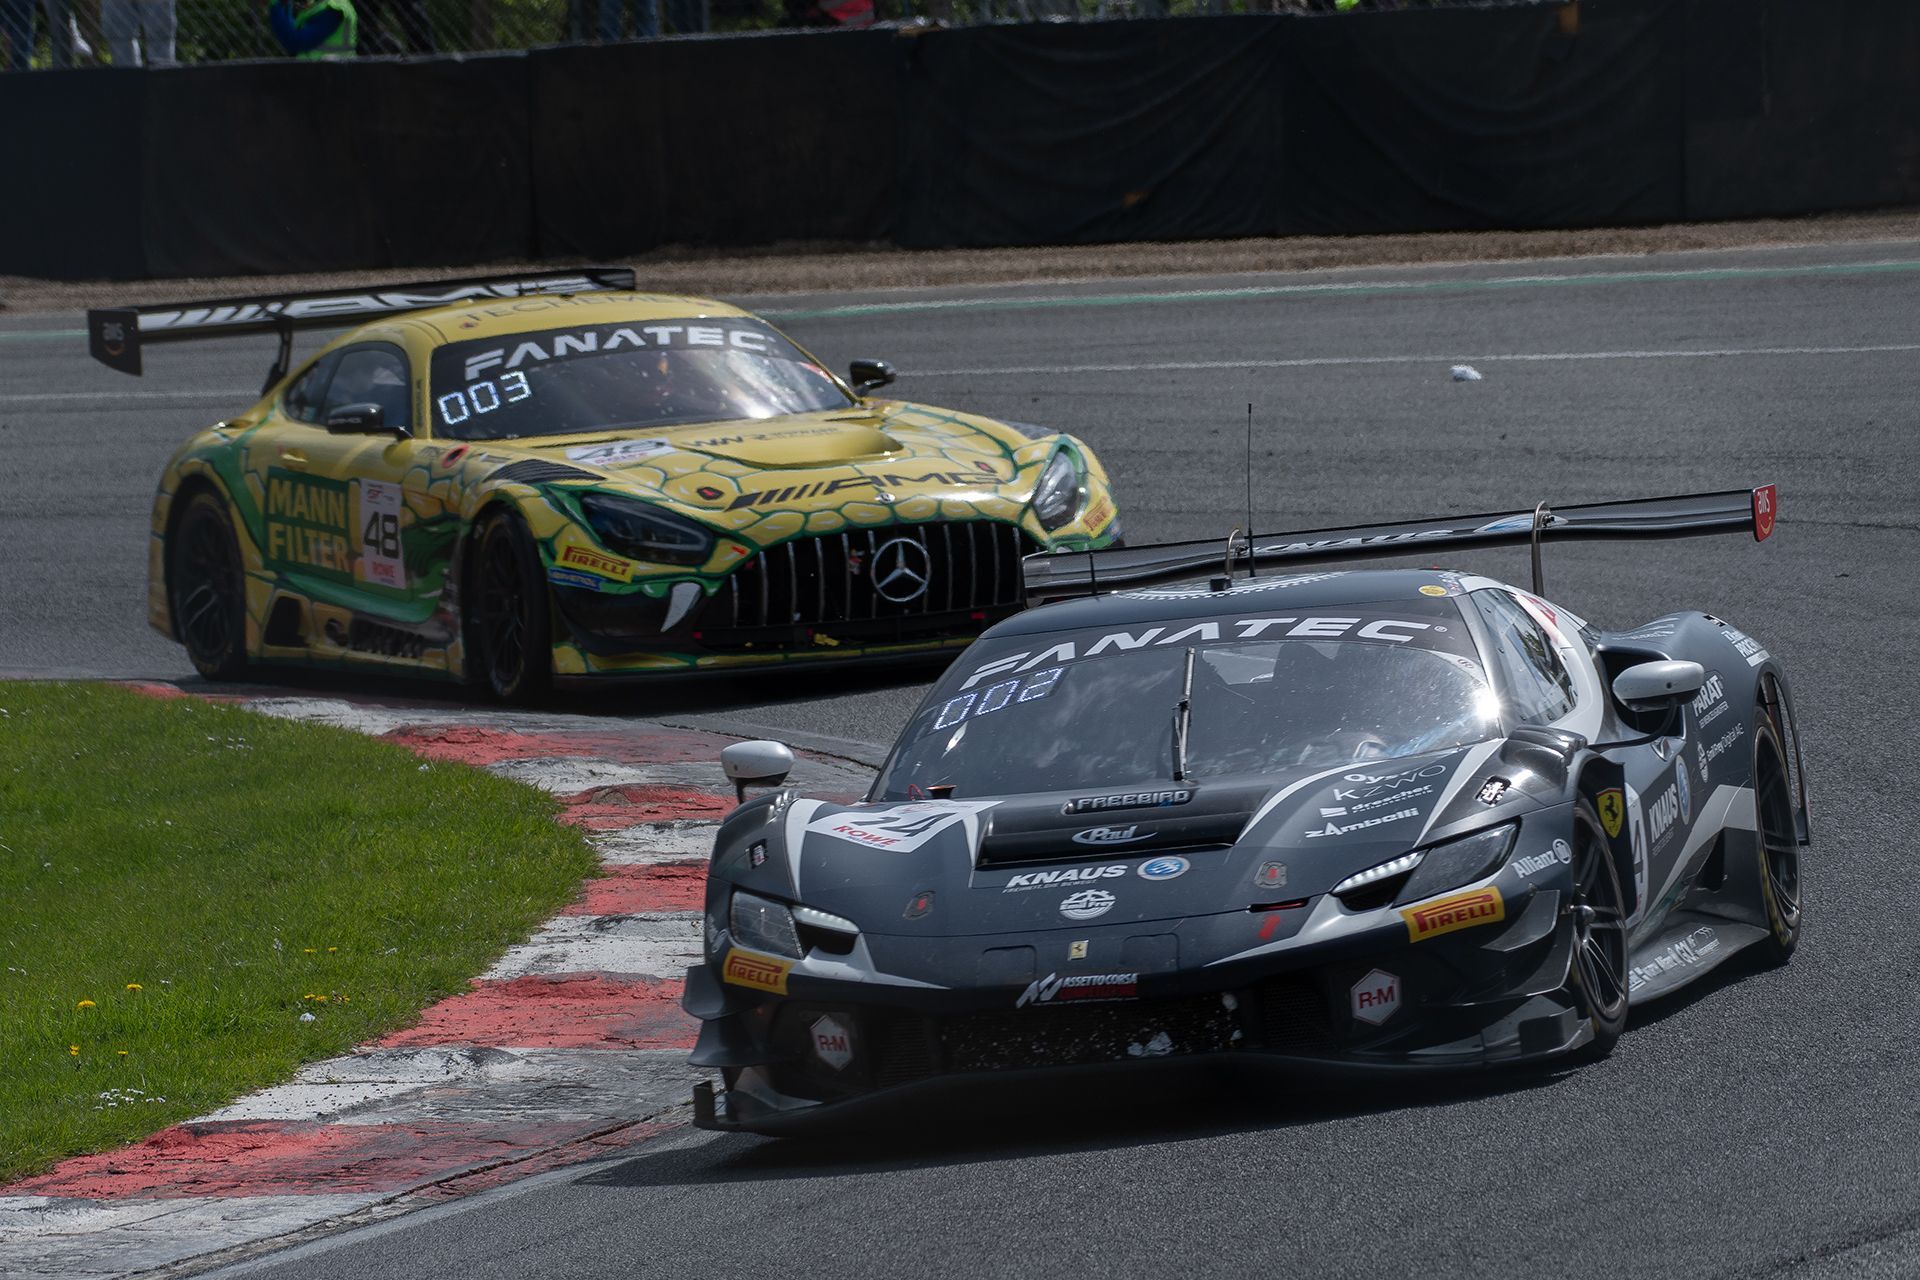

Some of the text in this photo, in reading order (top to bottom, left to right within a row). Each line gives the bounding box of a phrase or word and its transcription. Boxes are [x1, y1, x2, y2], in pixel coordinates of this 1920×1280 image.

[465, 325, 768, 381] FANATEC
[437, 370, 532, 425] 003
[823, 471, 1008, 496] AMG
[269, 477, 347, 530] MANN
[269, 520, 350, 573] FILTER
[364, 511, 400, 560] 48
[563, 545, 630, 576] PIRELLI
[959, 617, 1431, 691] FANATEC
[933, 668, 1063, 730] 002
[1691, 674, 1724, 717] PARAT
[1077, 790, 1190, 810] FREEBIRD
[1351, 784, 1433, 813] drescher
[832, 825, 901, 846] ROWE
[850, 813, 957, 837] 14
[1089, 825, 1138, 843] Paul
[1005, 864, 1129, 889] KNAUS
[1511, 849, 1558, 879] Allianz
[1413, 894, 1496, 933] PIRELLI
[728, 955, 784, 986] PIRELLI
[1061, 972, 1139, 988] ASSETTO CORSA
[1358, 985, 1395, 1009] R-M
[817, 1035, 847, 1052] R-M
